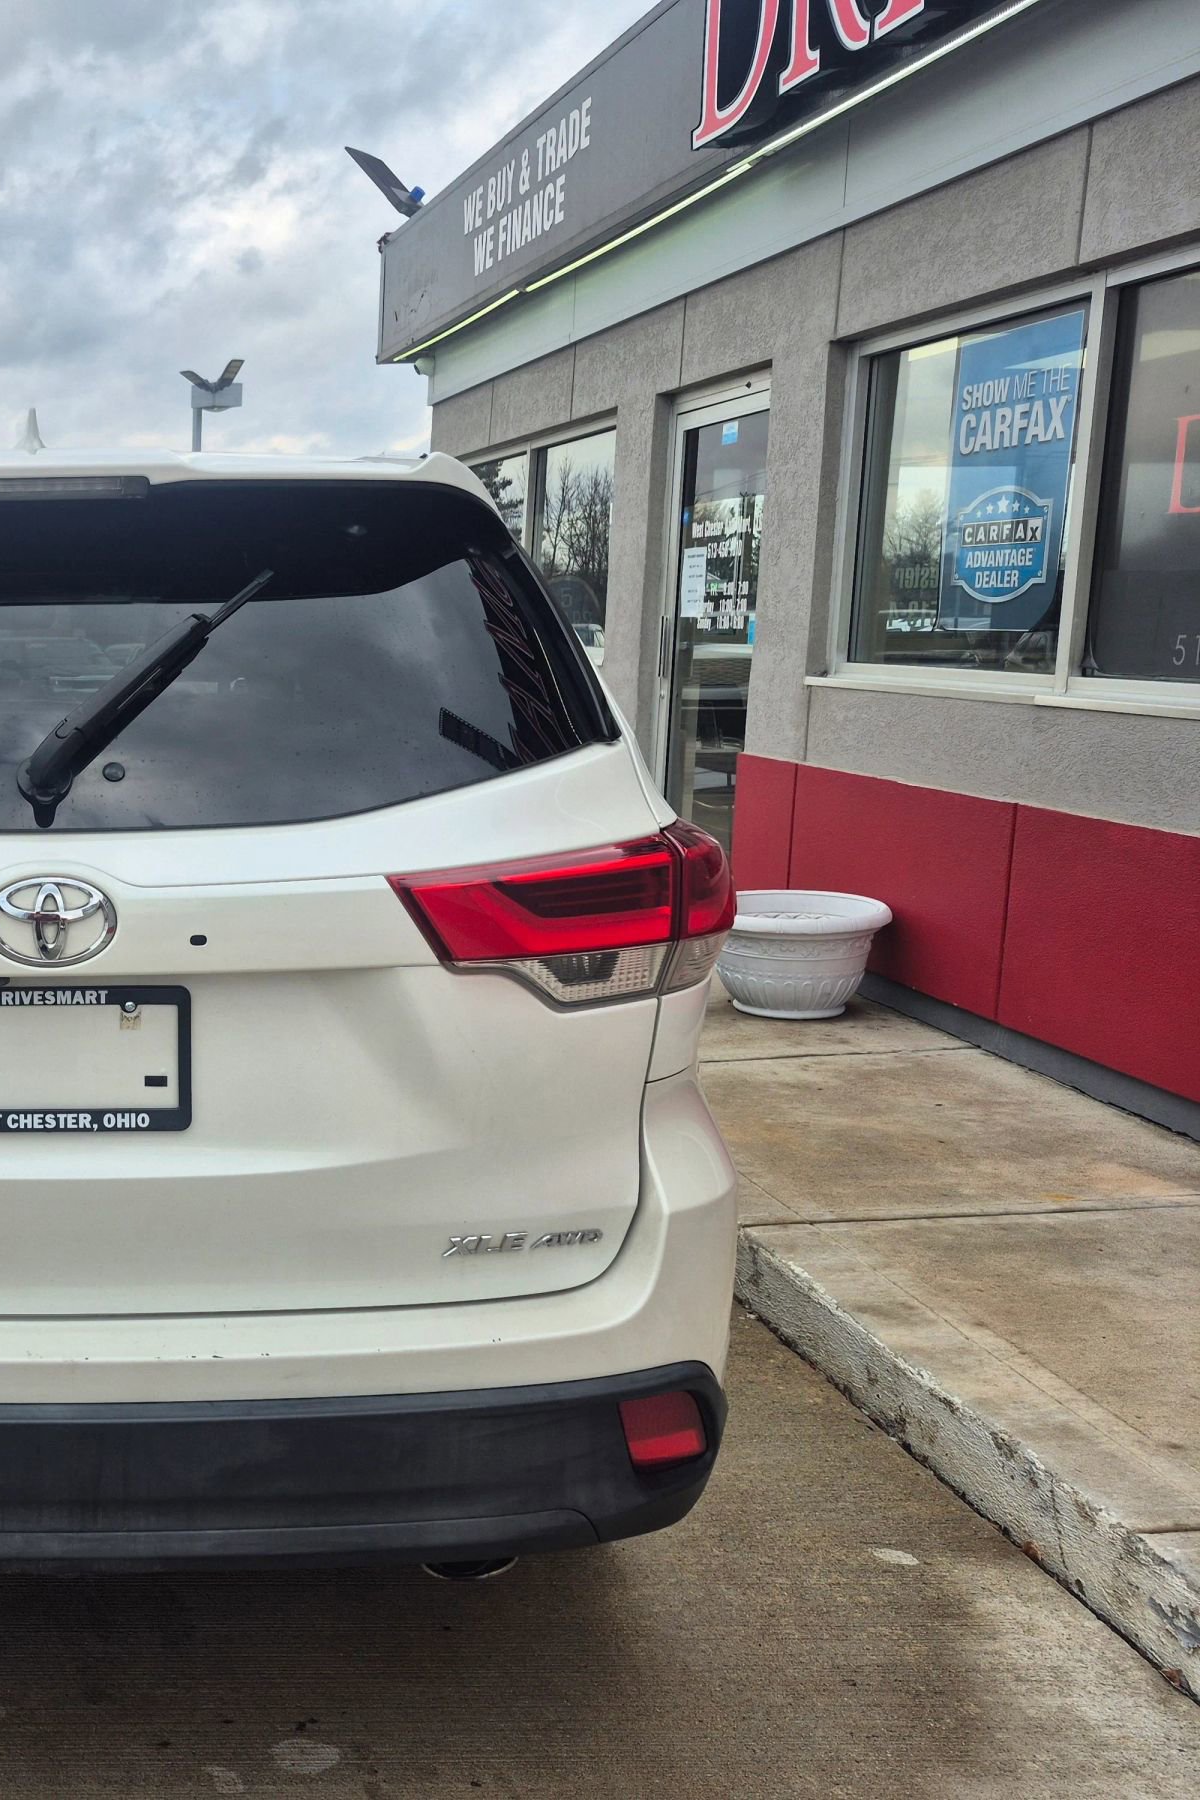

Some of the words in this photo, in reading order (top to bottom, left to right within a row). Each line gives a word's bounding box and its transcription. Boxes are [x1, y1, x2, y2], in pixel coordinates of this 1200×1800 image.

[464, 185, 484, 235] WE
[486, 159, 515, 219] BUY
[518, 148, 531, 195] &
[536, 96, 592, 182] TRADE
[474, 225, 495, 277] WE
[497, 174, 566, 262] FINANCE
[962, 376, 1010, 412] SHOW
[1013, 371, 1037, 401] ME
[1041, 363, 1073, 394] THE
[958, 395, 1069, 456] CARFAX
[962, 518, 1042, 546] CARFAX
[964, 547, 1034, 569] ADVANTAGE
[974, 568, 1020, 589] DEALER
[6, 1112, 99, 1132] CHESTER,
[102, 1112, 150, 1128] OHIO
[442, 1231, 529, 1257] XLE
[529, 1227, 604, 1250] AWD
